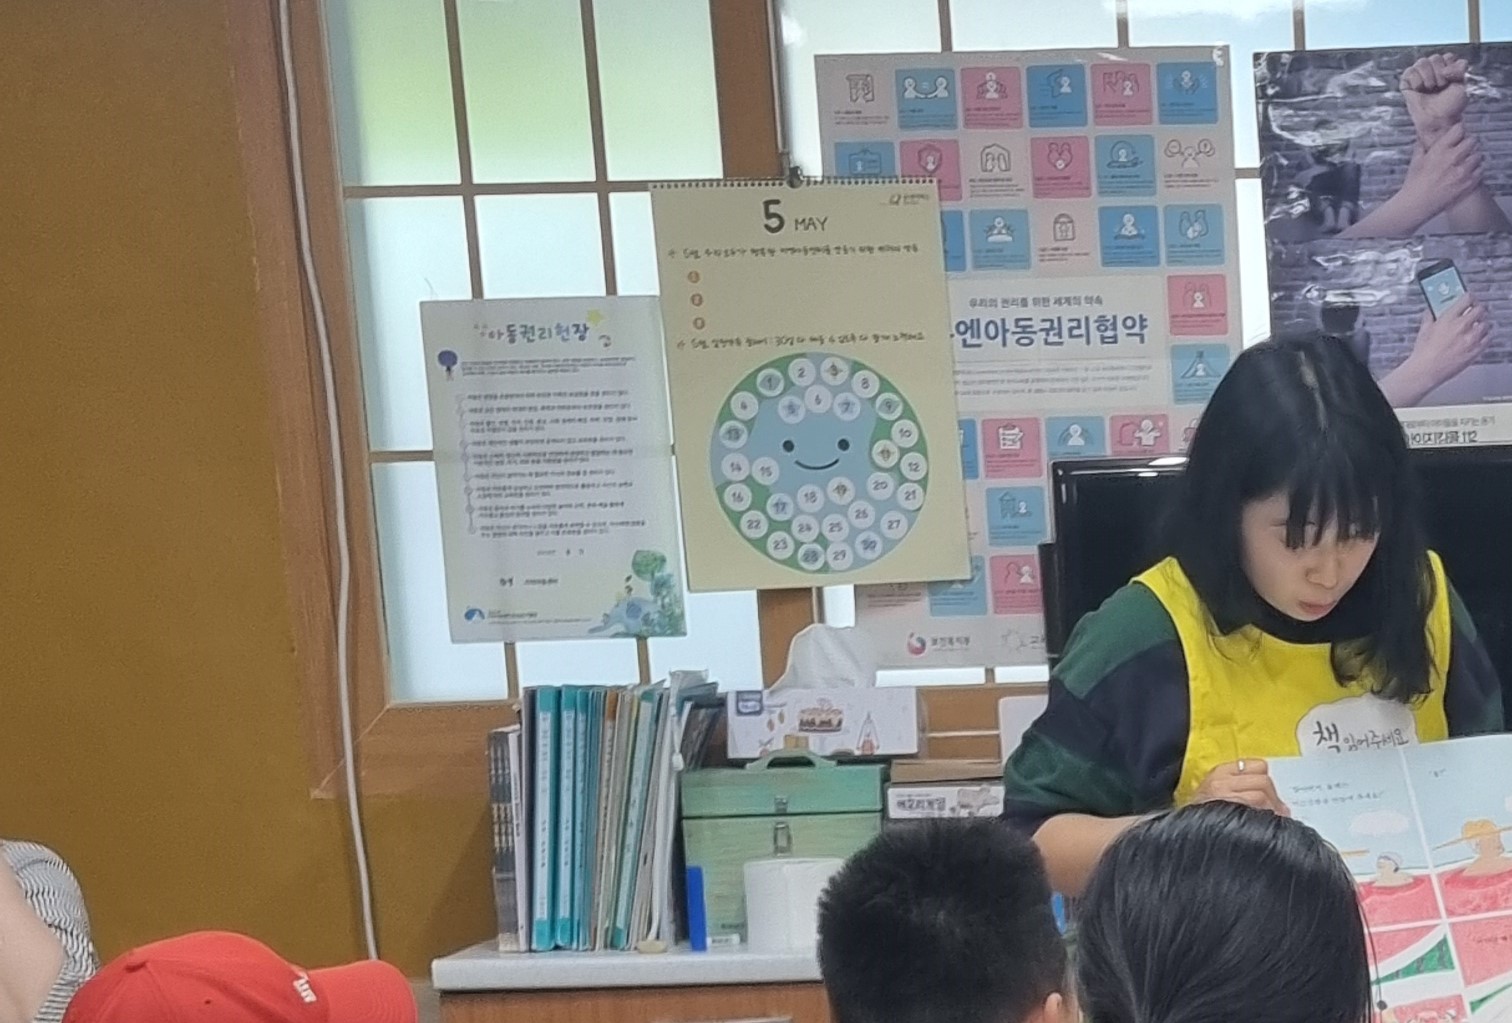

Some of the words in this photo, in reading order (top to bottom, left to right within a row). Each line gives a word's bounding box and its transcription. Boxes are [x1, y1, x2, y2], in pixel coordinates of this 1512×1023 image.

[763, 199, 785, 233] 5
[794, 216, 829, 231] MAY
[969, 296, 998, 309] 우리의
[1001, 296, 1029, 309] 권리를
[1032, 295, 1051, 308] 위한
[1052, 295, 1082, 308] 세계의
[1084, 294, 1103, 307] 약속
[488, 322, 590, 345] 아동권리헌장
[951, 313, 1149, 349] 엔아동권리협약
[899, 428, 911, 438] 10
[730, 461, 742, 472] 14
[760, 465, 773, 477] 15
[908, 461, 920, 472] 12
[873, 480, 888, 490] 20
[731, 491, 743, 503] 16
[804, 491, 817, 503] 18
[904, 490, 917, 501] 21
[747, 519, 761, 529] 22
[798, 522, 812, 534] 24
[829, 522, 843, 533] 25
[887, 519, 901, 530] 27
[773, 539, 788, 550] 23
[1312, 720, 1341, 754] 책
